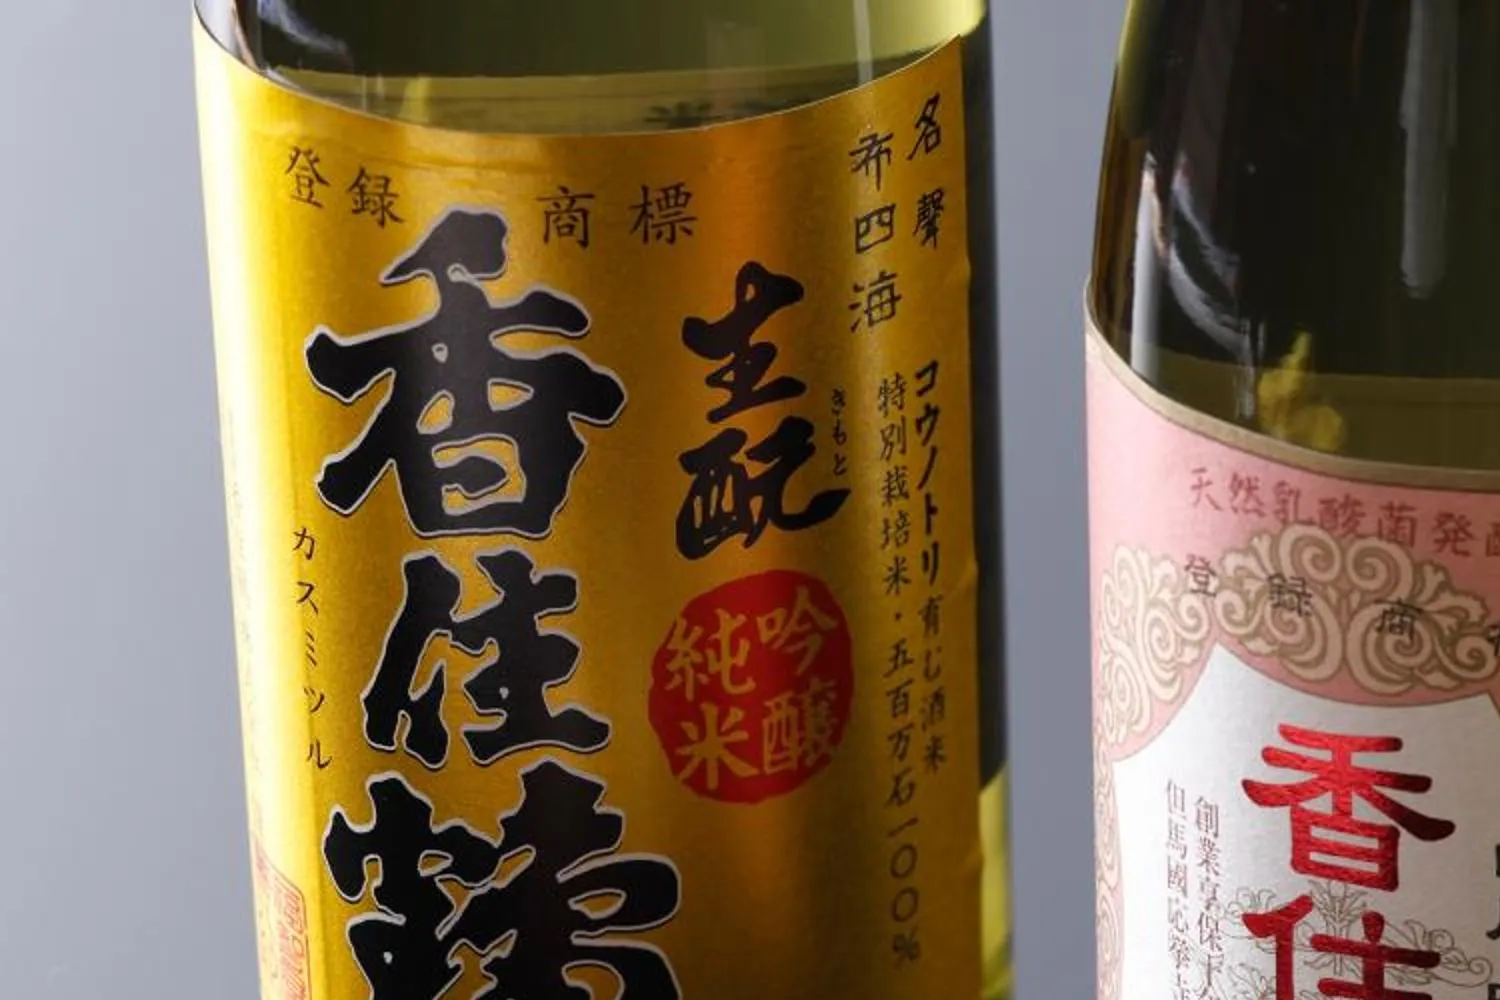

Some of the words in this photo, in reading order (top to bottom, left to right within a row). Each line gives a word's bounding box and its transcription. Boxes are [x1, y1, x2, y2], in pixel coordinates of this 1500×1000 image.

[831, 387, 847, 477] きもと
[293, 527, 332, 769] カスミツル
